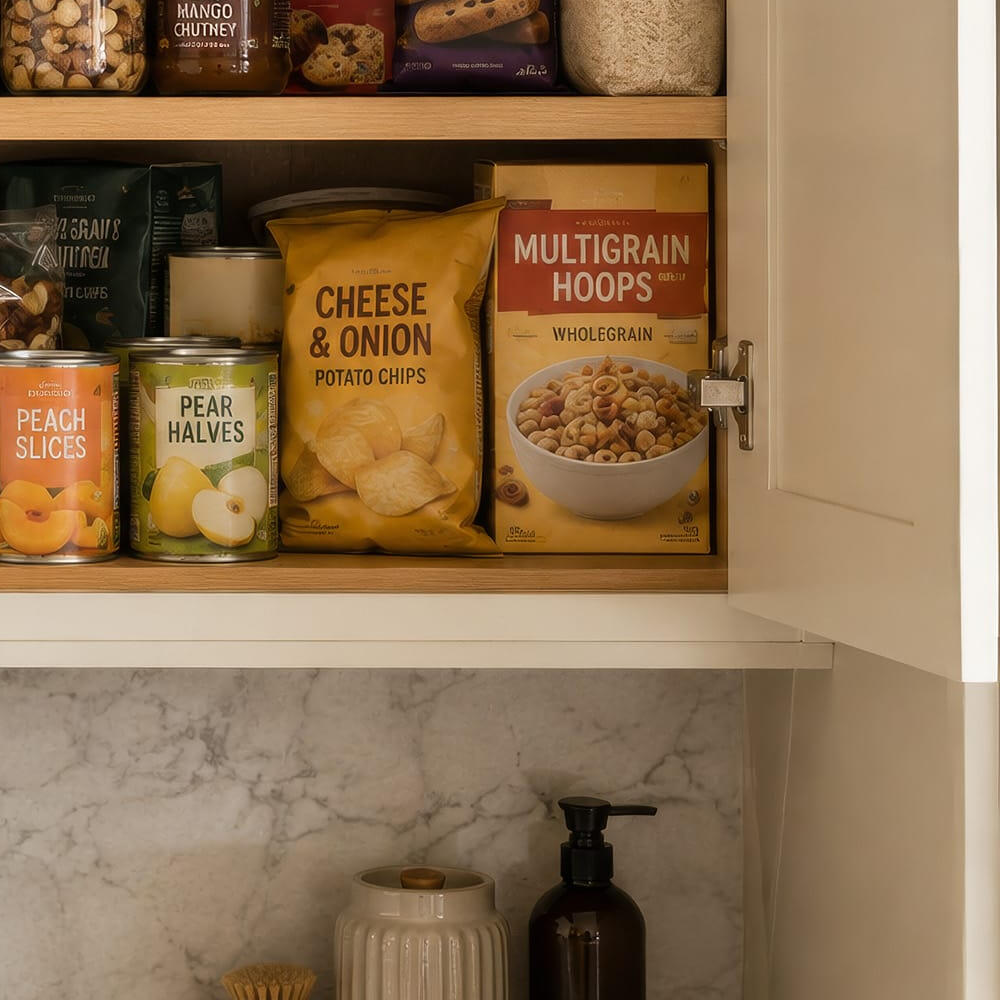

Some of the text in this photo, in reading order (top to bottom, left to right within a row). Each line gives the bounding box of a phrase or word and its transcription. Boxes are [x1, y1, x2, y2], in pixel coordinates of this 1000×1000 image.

[177, 3, 233, 19] MANGO
[174, 22, 237, 37] CHUTNEY
[514, 233, 690, 265] MULTIGRAIN
[553, 271, 653, 303] HOOPS
[315, 282, 427, 319] CHEESE
[309, 322, 432, 358] & ONION
[552, 326, 653, 342] WHOLEGRAIN
[315, 367, 426, 387] POTATO CHIPS
[180, 395, 233, 418] PEAR
[17, 407, 86, 432] PEACH
[168, 420, 244, 443] HALVES
[16, 435, 87, 459] SLICES
